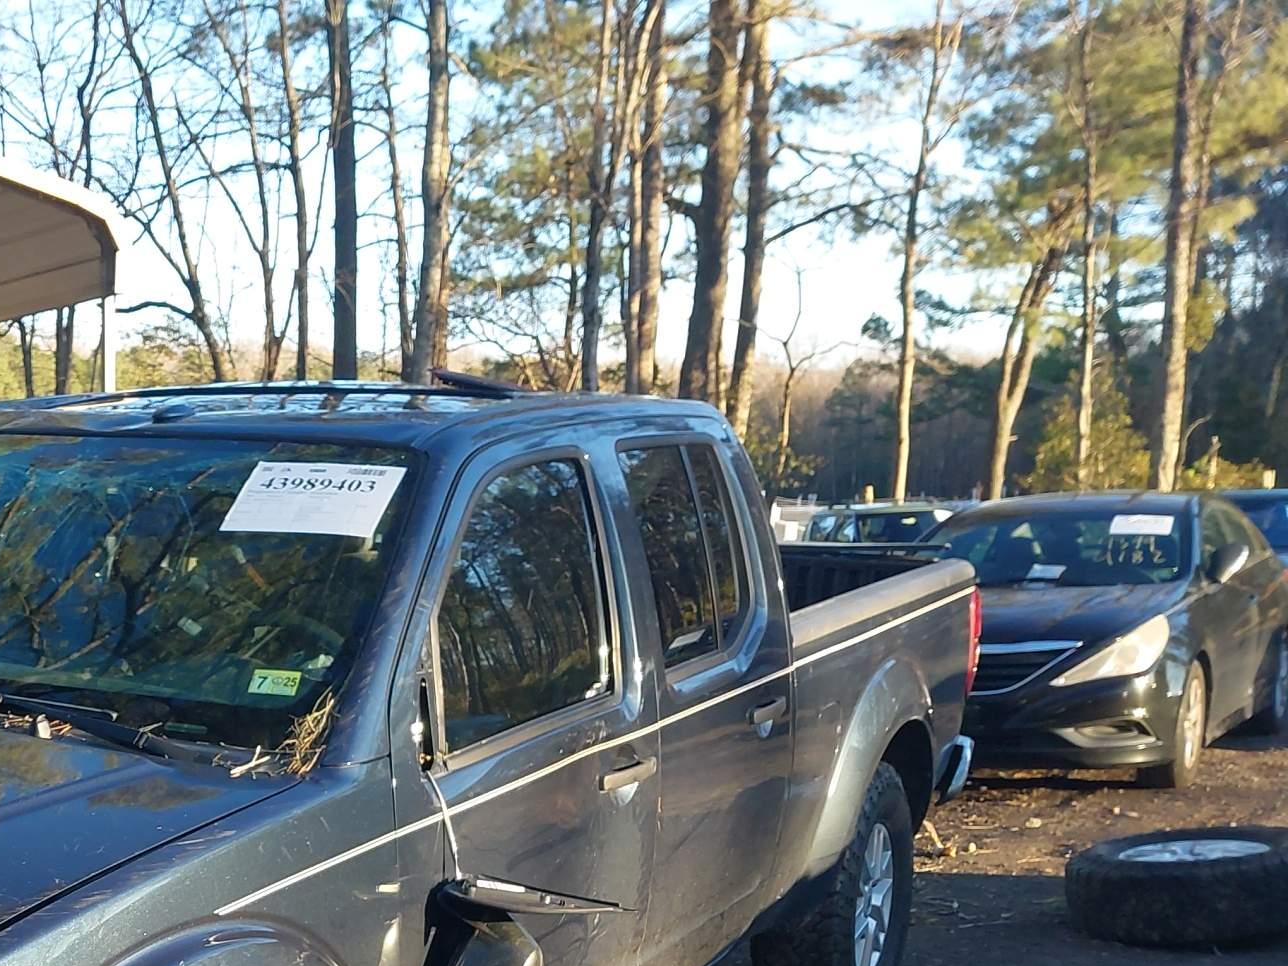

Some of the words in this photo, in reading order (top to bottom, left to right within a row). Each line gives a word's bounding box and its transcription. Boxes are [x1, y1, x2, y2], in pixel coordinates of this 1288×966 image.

[260, 476, 377, 493] 43989403
[257, 676, 268, 689] 7
[283, 676, 298, 688] 25
